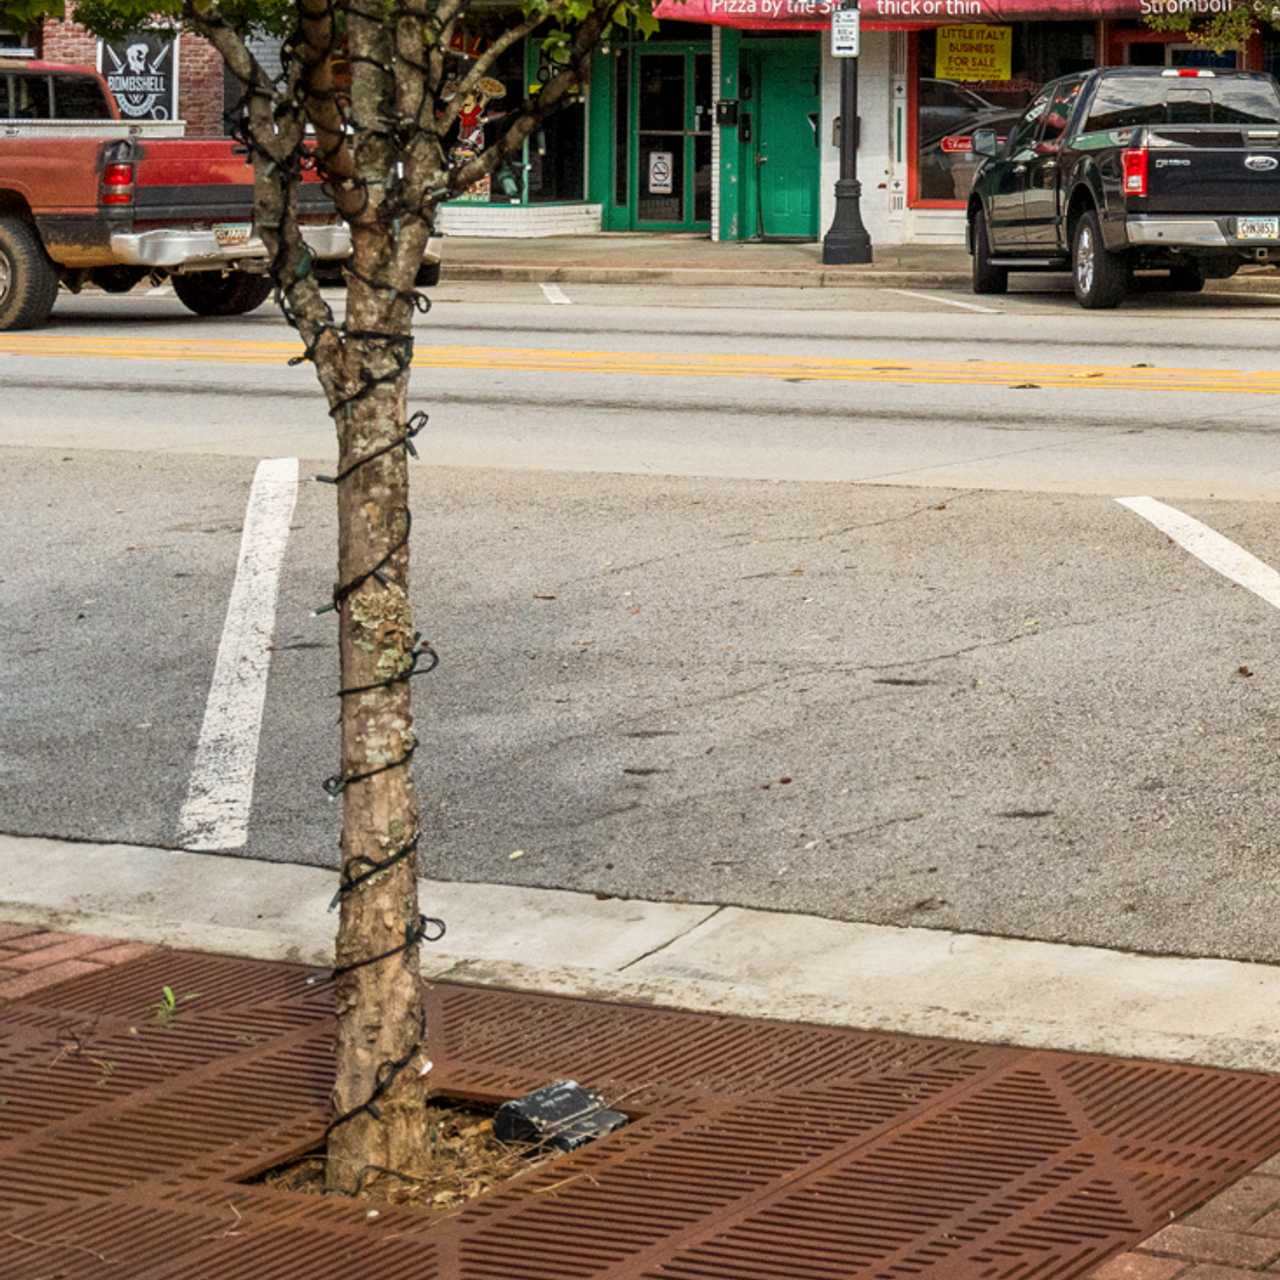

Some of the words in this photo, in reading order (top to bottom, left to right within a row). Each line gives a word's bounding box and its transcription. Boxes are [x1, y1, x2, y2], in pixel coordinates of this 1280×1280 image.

[923, 0, 942, 14] or
[942, 28, 974, 39] LITTLE
[976, 29, 1005, 40] ITALY
[948, 42, 995, 54] BUSINESS
[948, 55, 968, 66] FOR
[971, 57, 996, 67] SALE
[107, 76, 166, 91] BOMBSHELL
